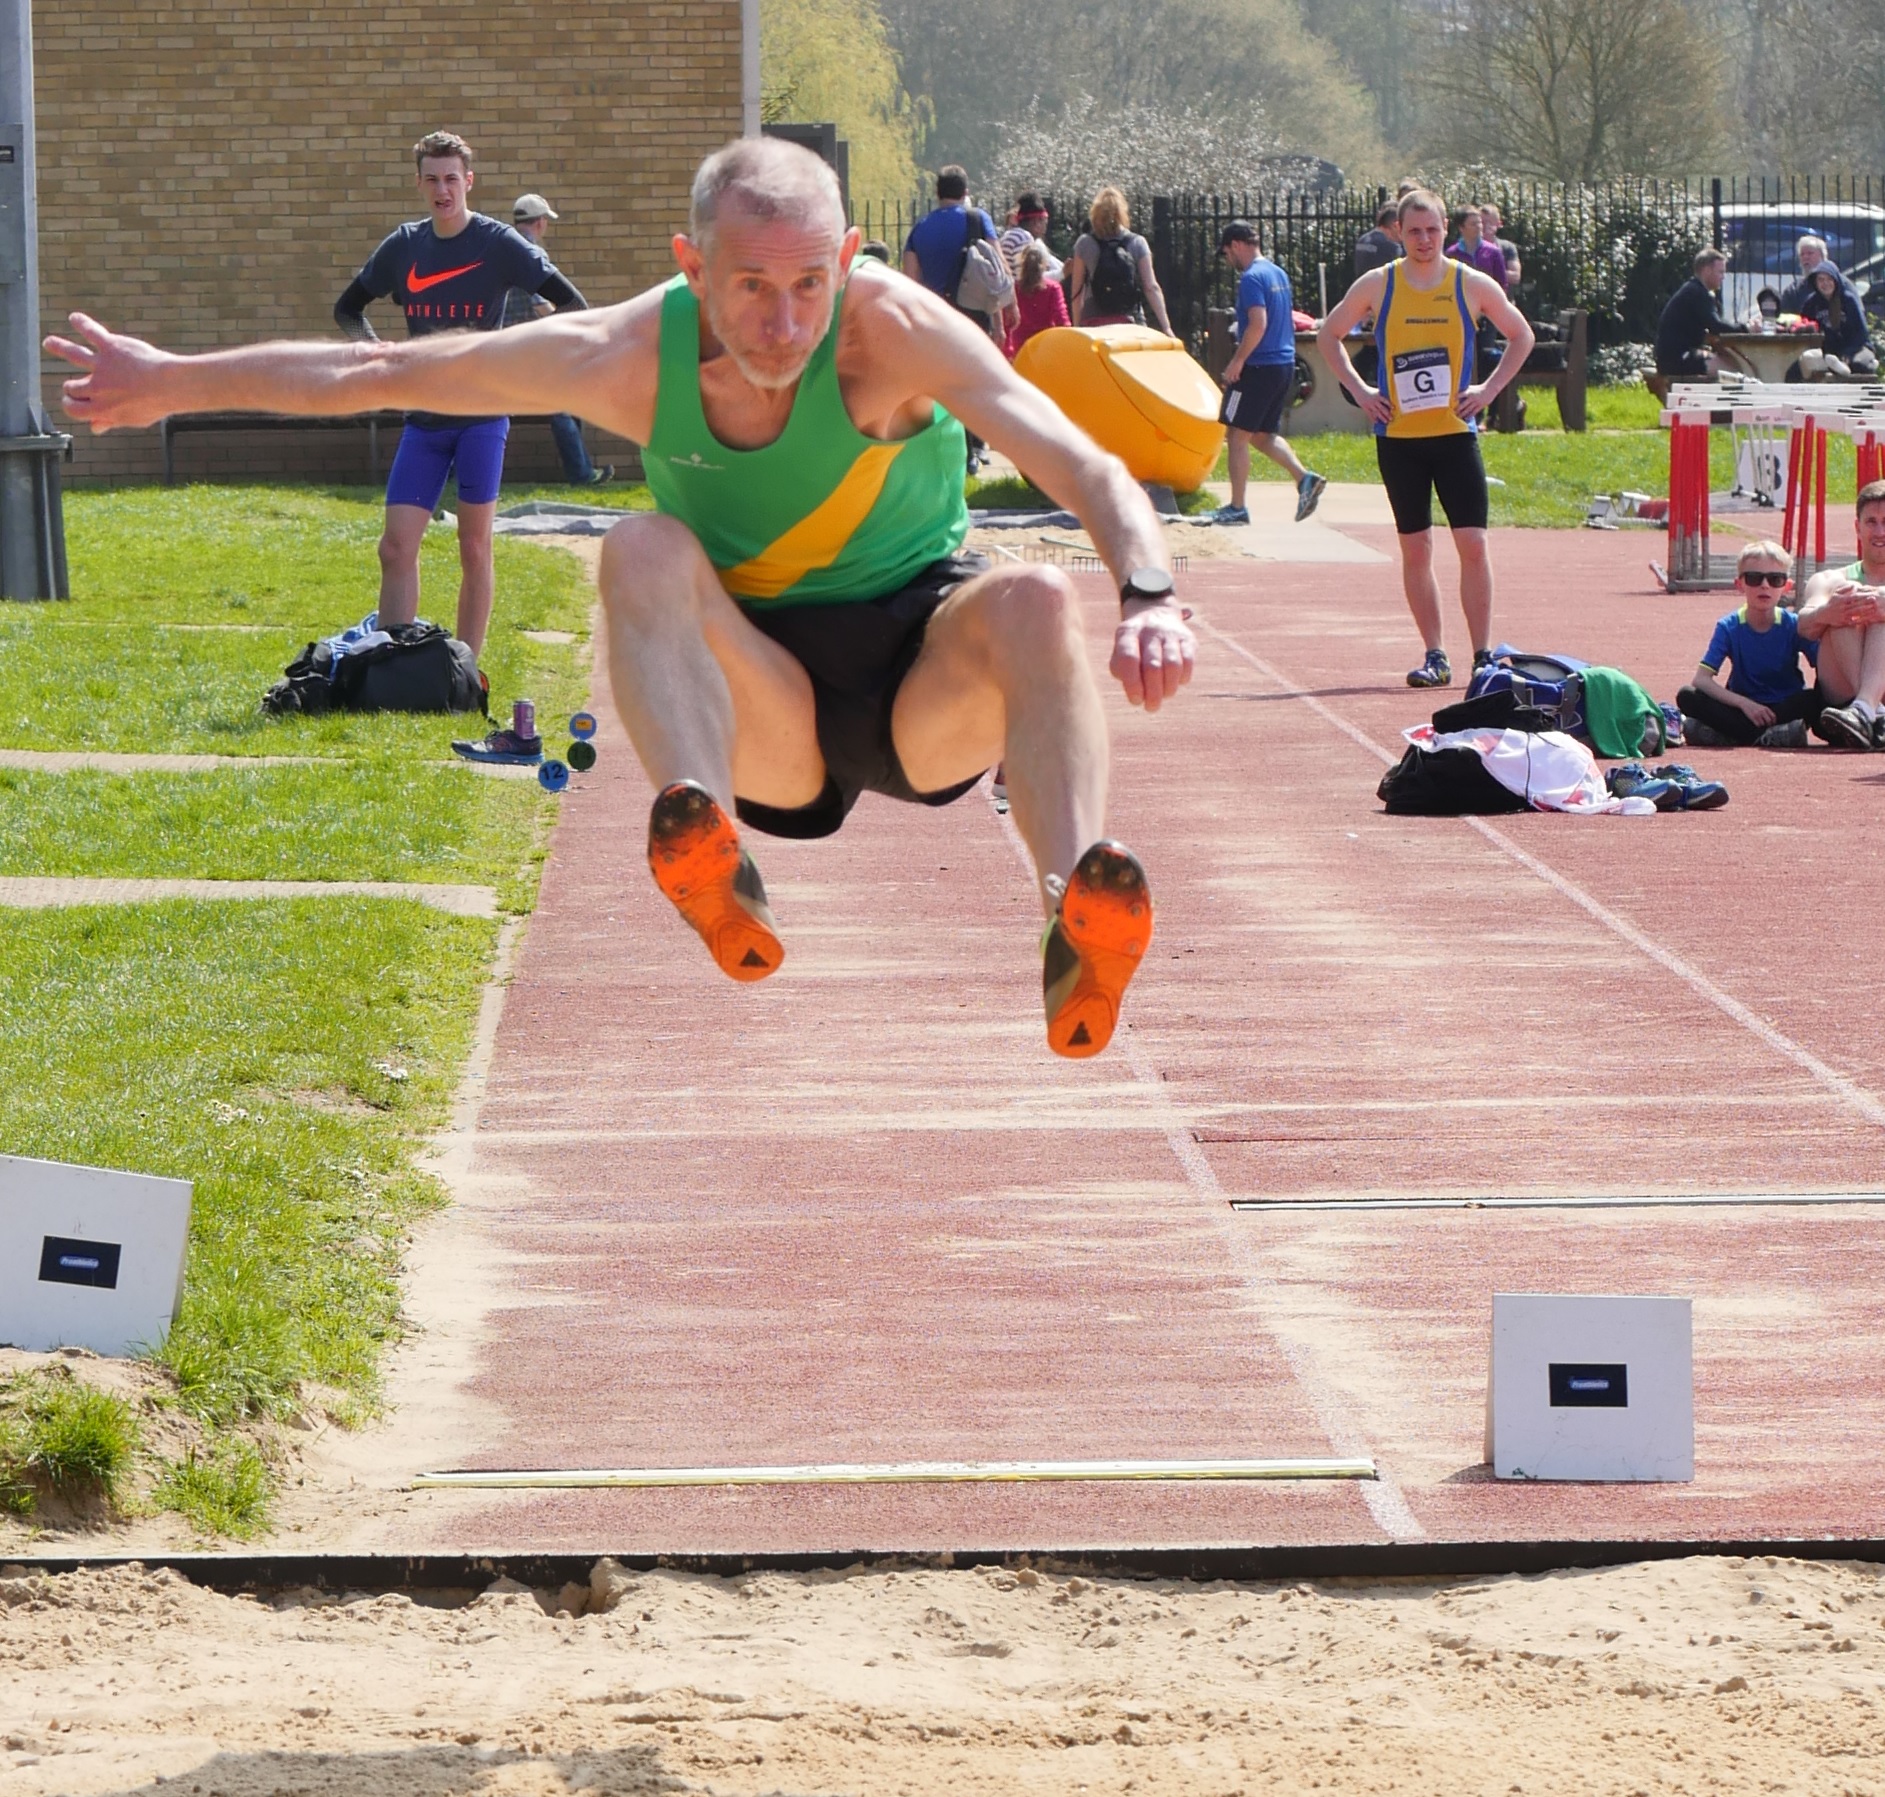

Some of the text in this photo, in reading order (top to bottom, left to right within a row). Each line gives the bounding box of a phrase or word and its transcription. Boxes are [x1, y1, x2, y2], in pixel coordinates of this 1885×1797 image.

[407, 303, 485, 318] ATHLETE
[1414, 370, 1435, 393] G
[540, 763, 564, 781] 12
